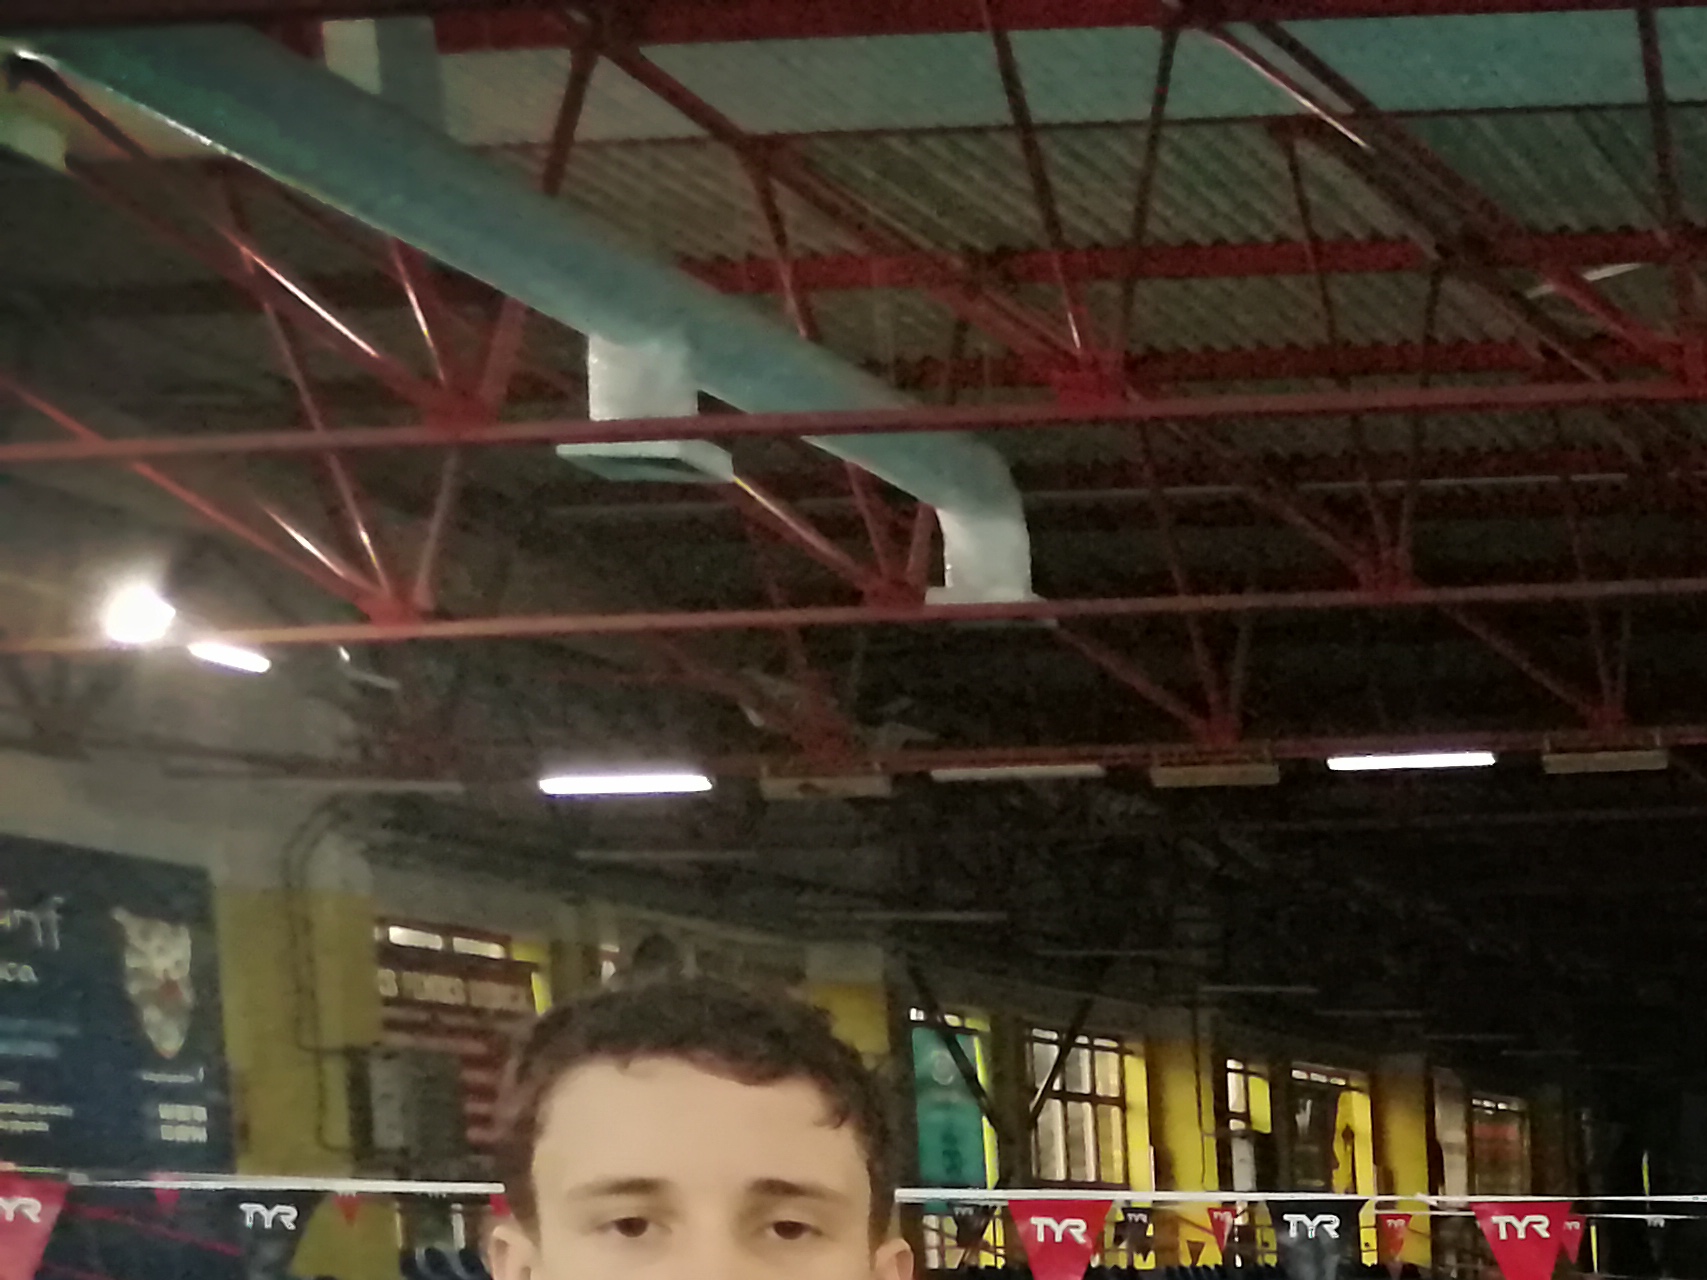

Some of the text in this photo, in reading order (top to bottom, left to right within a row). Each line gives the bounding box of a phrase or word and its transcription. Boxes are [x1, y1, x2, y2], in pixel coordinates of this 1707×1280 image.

[0, 1198, 42, 1223] YR
[240, 1203, 298, 1230] TYR
[1030, 1217, 1088, 1244] TYR
[1283, 1214, 1341, 1238] TYR
[1491, 1215, 1550, 1240] TYR
